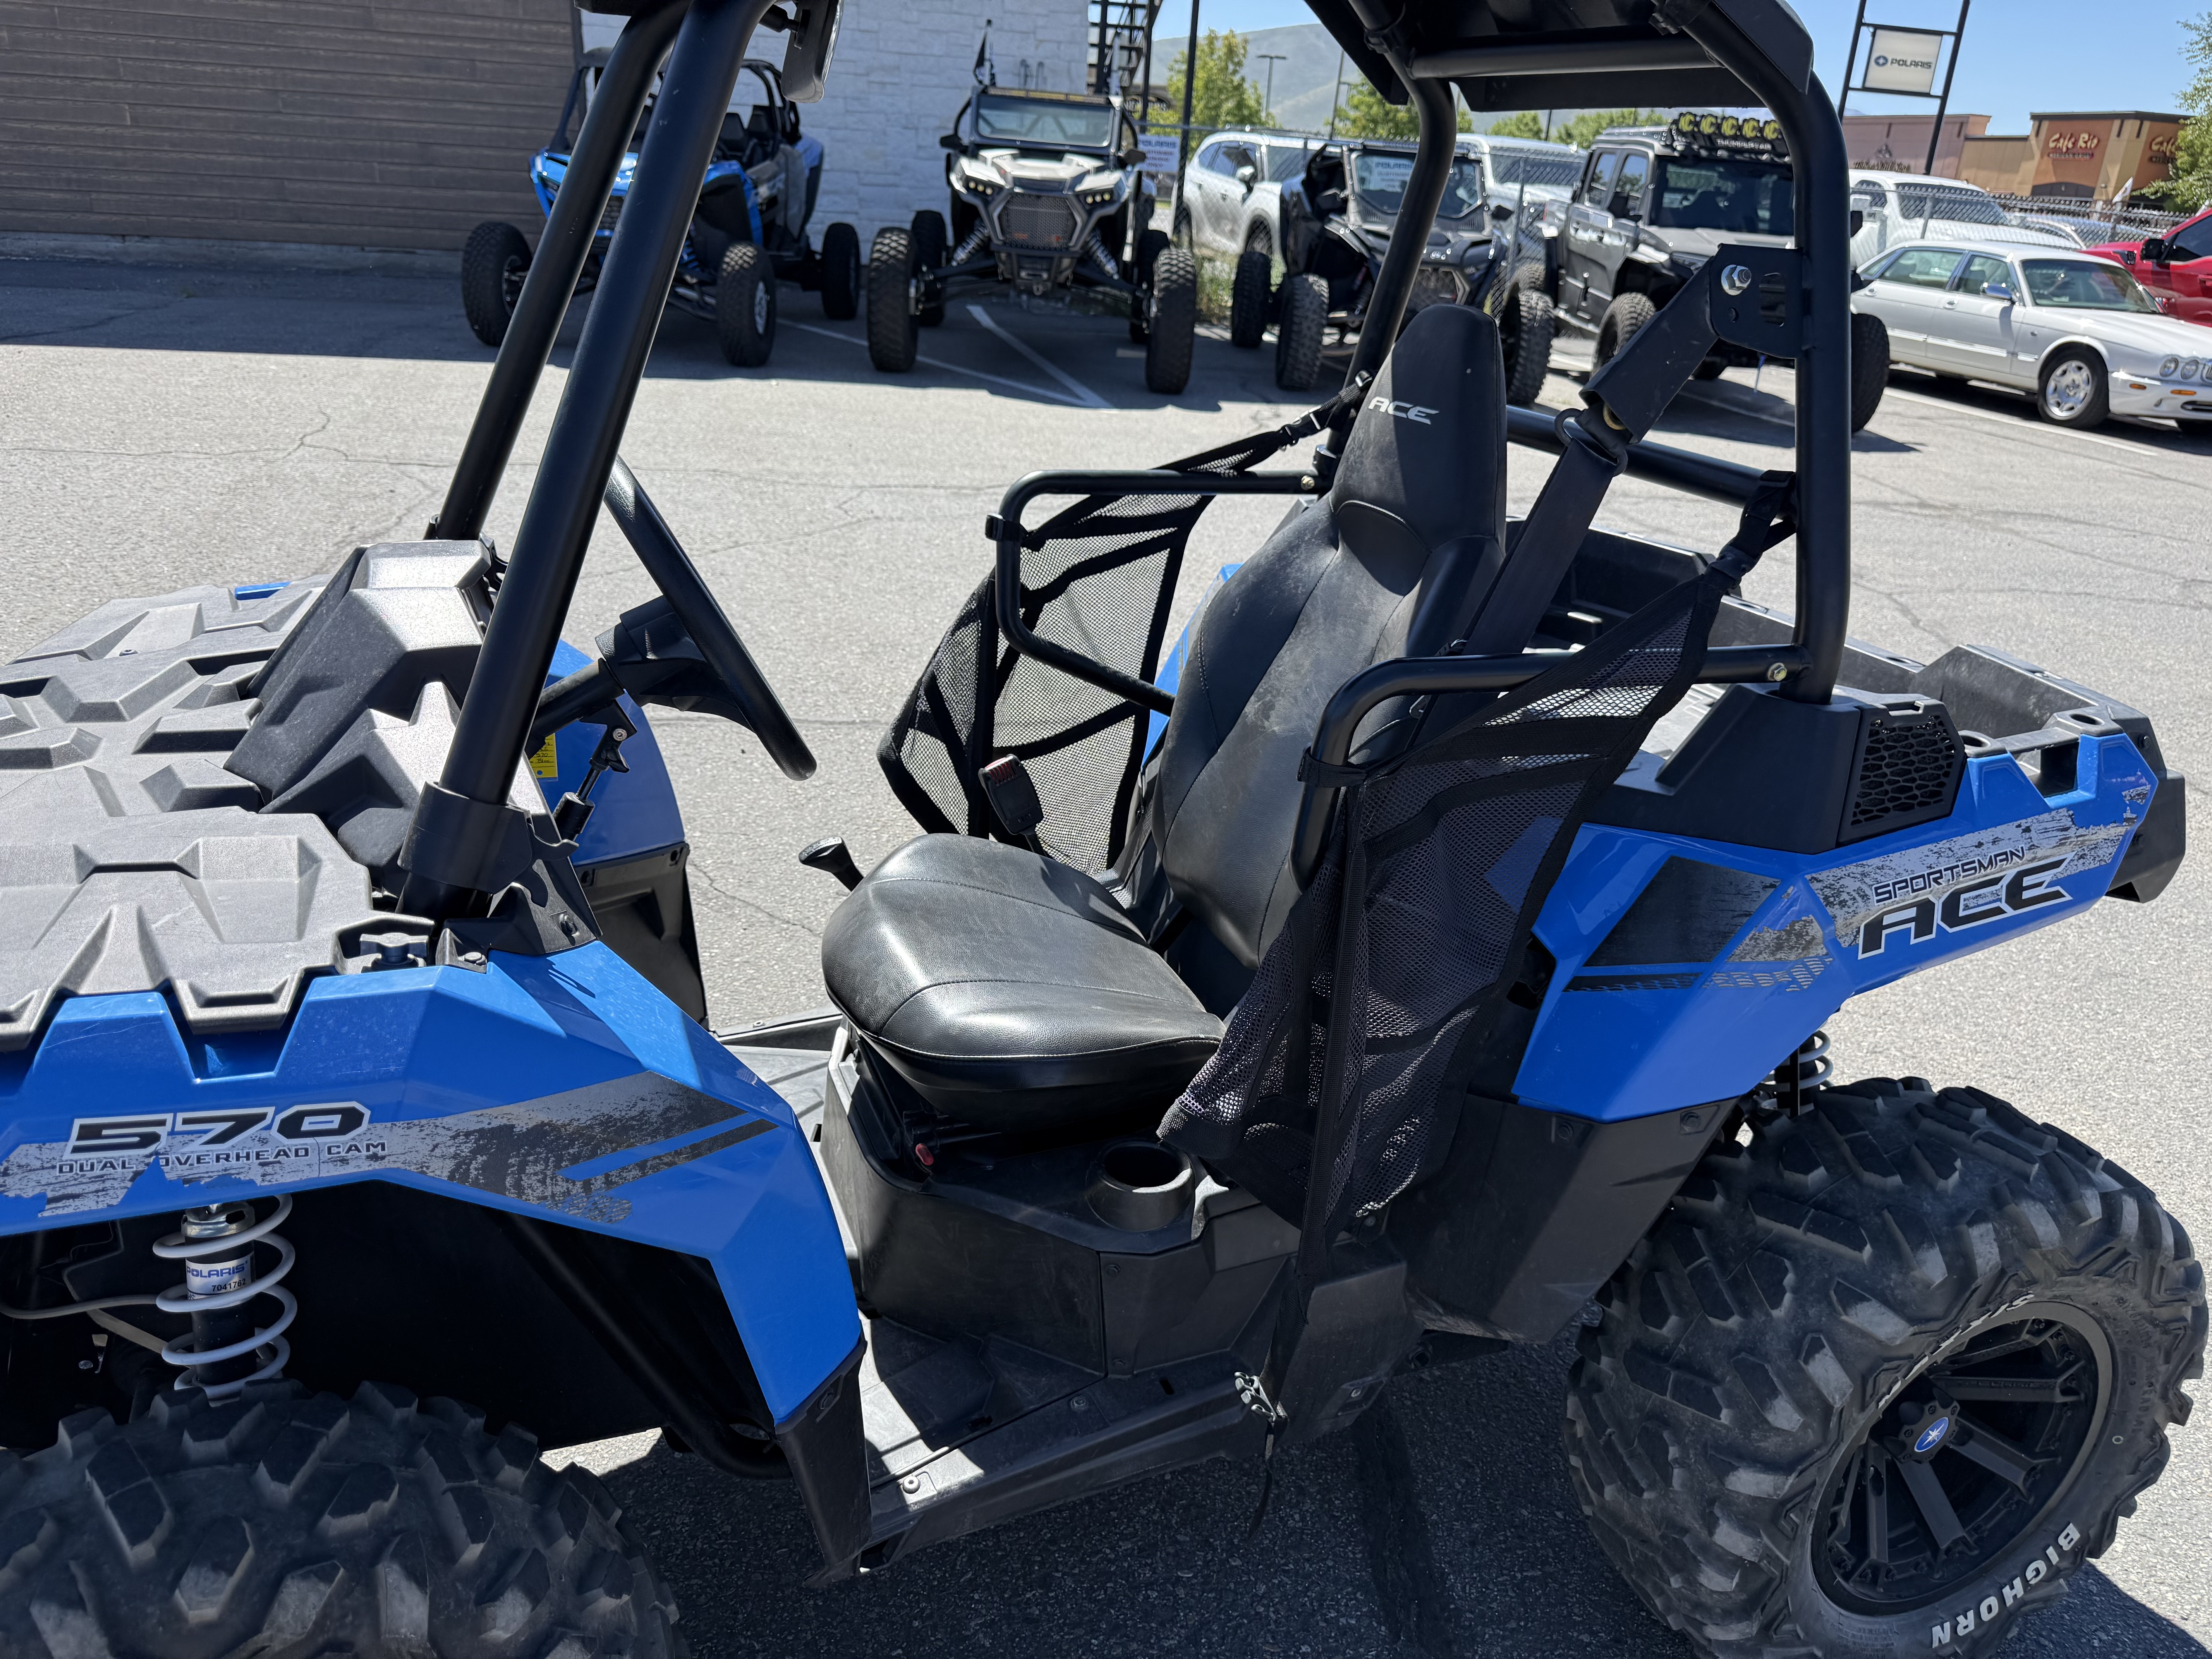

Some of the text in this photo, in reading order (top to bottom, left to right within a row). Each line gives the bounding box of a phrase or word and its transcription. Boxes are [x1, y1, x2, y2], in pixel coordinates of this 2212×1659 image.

[1890, 58, 1932, 69] POLARIS
[1368, 396, 1439, 425] ACE
[1873, 846, 2025, 905] SPORTSMAN
[1859, 852, 2076, 959] ACE
[63, 1101, 371, 1159] 570
[57, 1159, 136, 1175] DUAL
[325, 1140, 387, 1156] CAM
[187, 1264, 245, 1278] POLARIS
[212, 1278, 246, 1291] 7041762
[1932, 1523, 2081, 1649] BIGHORN
